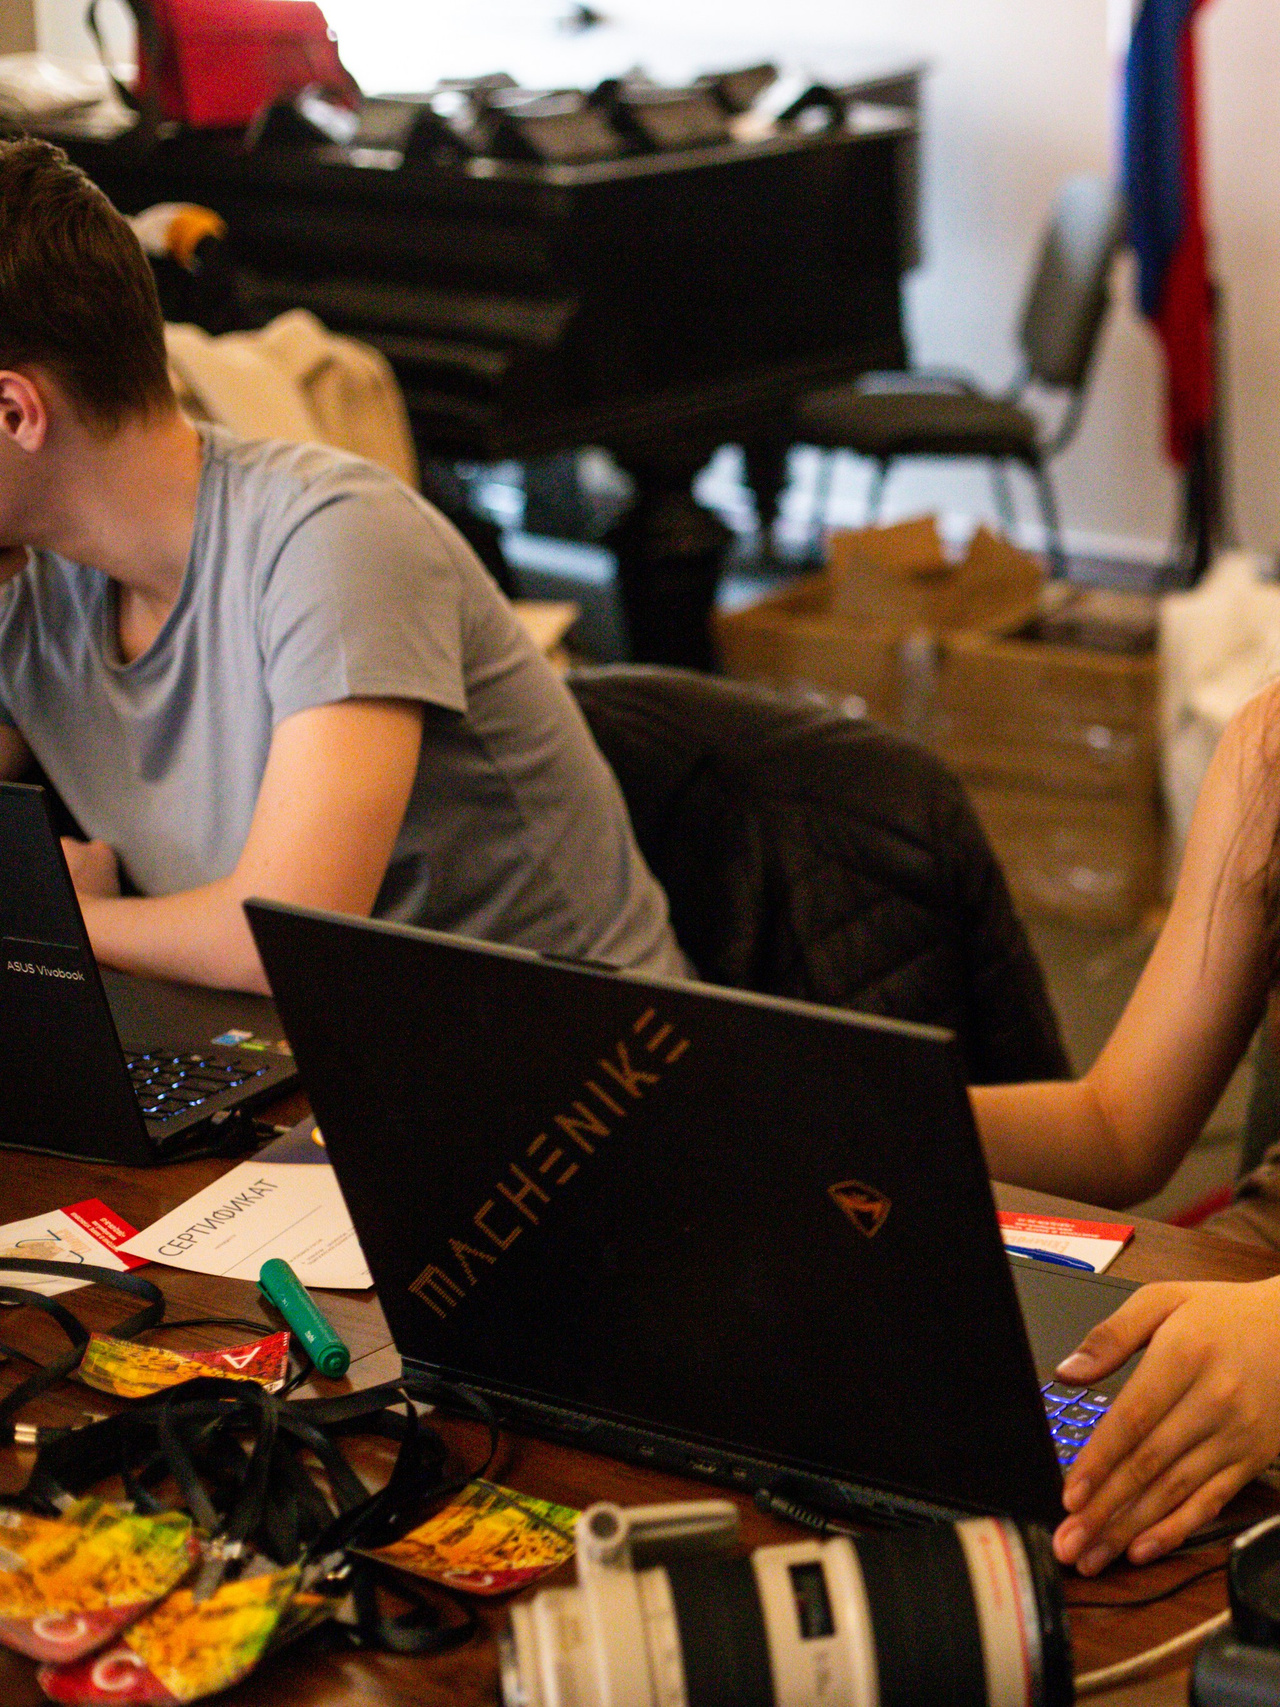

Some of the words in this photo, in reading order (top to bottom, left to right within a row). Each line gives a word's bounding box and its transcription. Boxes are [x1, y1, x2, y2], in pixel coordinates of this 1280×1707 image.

[7, 961, 35, 974] ASUS
[36, 964, 85, 982] Vivobook
[408, 1007, 690, 1319] MACHENIKE
[158, 1178, 278, 1257] СЕРТИФИКАТ
